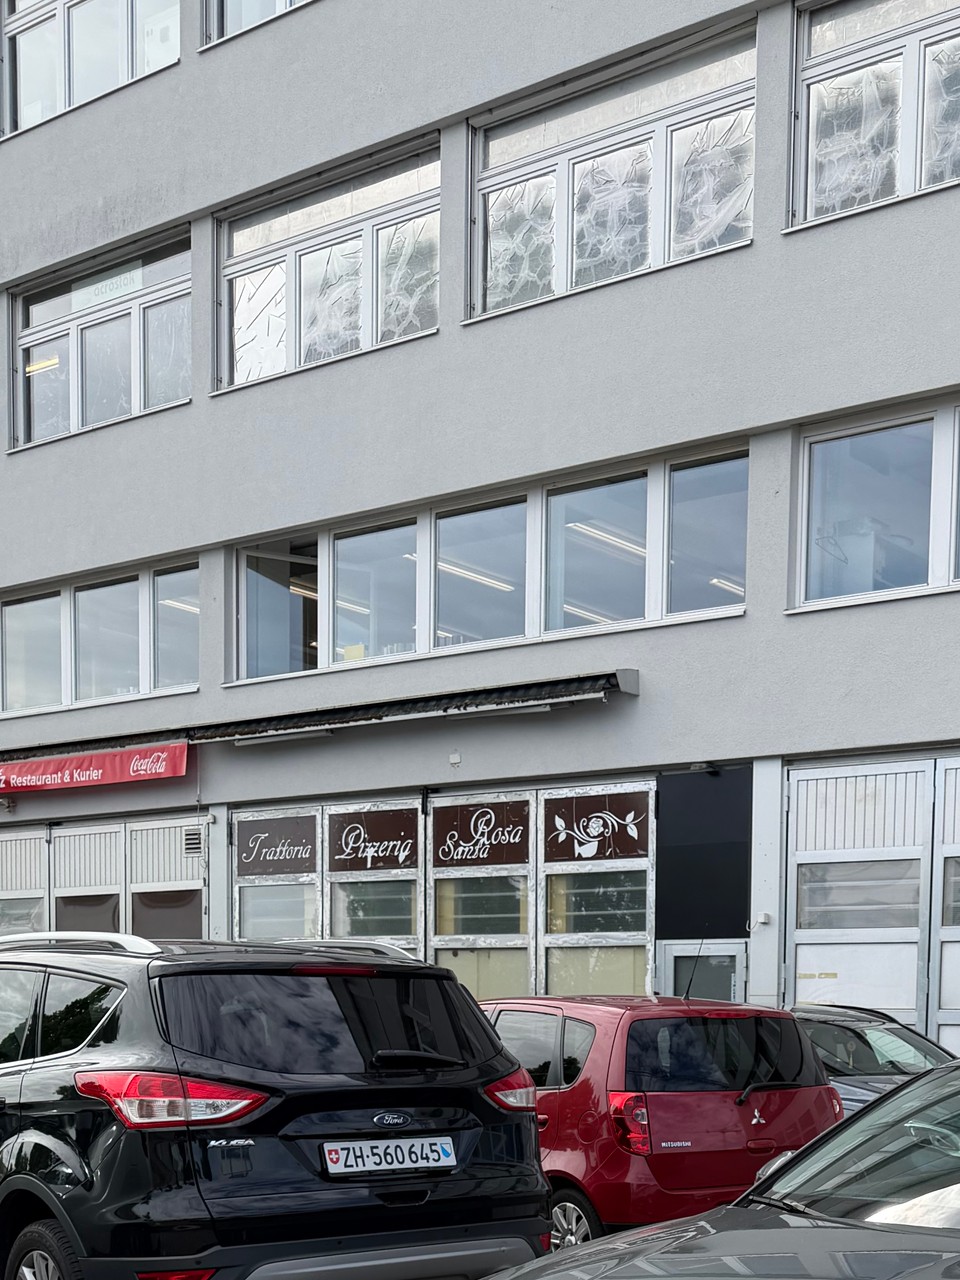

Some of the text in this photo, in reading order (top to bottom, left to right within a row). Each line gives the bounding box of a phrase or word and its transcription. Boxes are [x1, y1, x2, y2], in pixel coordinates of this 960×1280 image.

[10, 773, 61, 787] Restaurant
[63, 769, 71, 783] &
[73, 768, 103, 782] Kurier
[242, 832, 312, 863] Trattoria
[334, 823, 413, 863] Pizzeria
[438, 808, 524, 861] Santa Rosa
